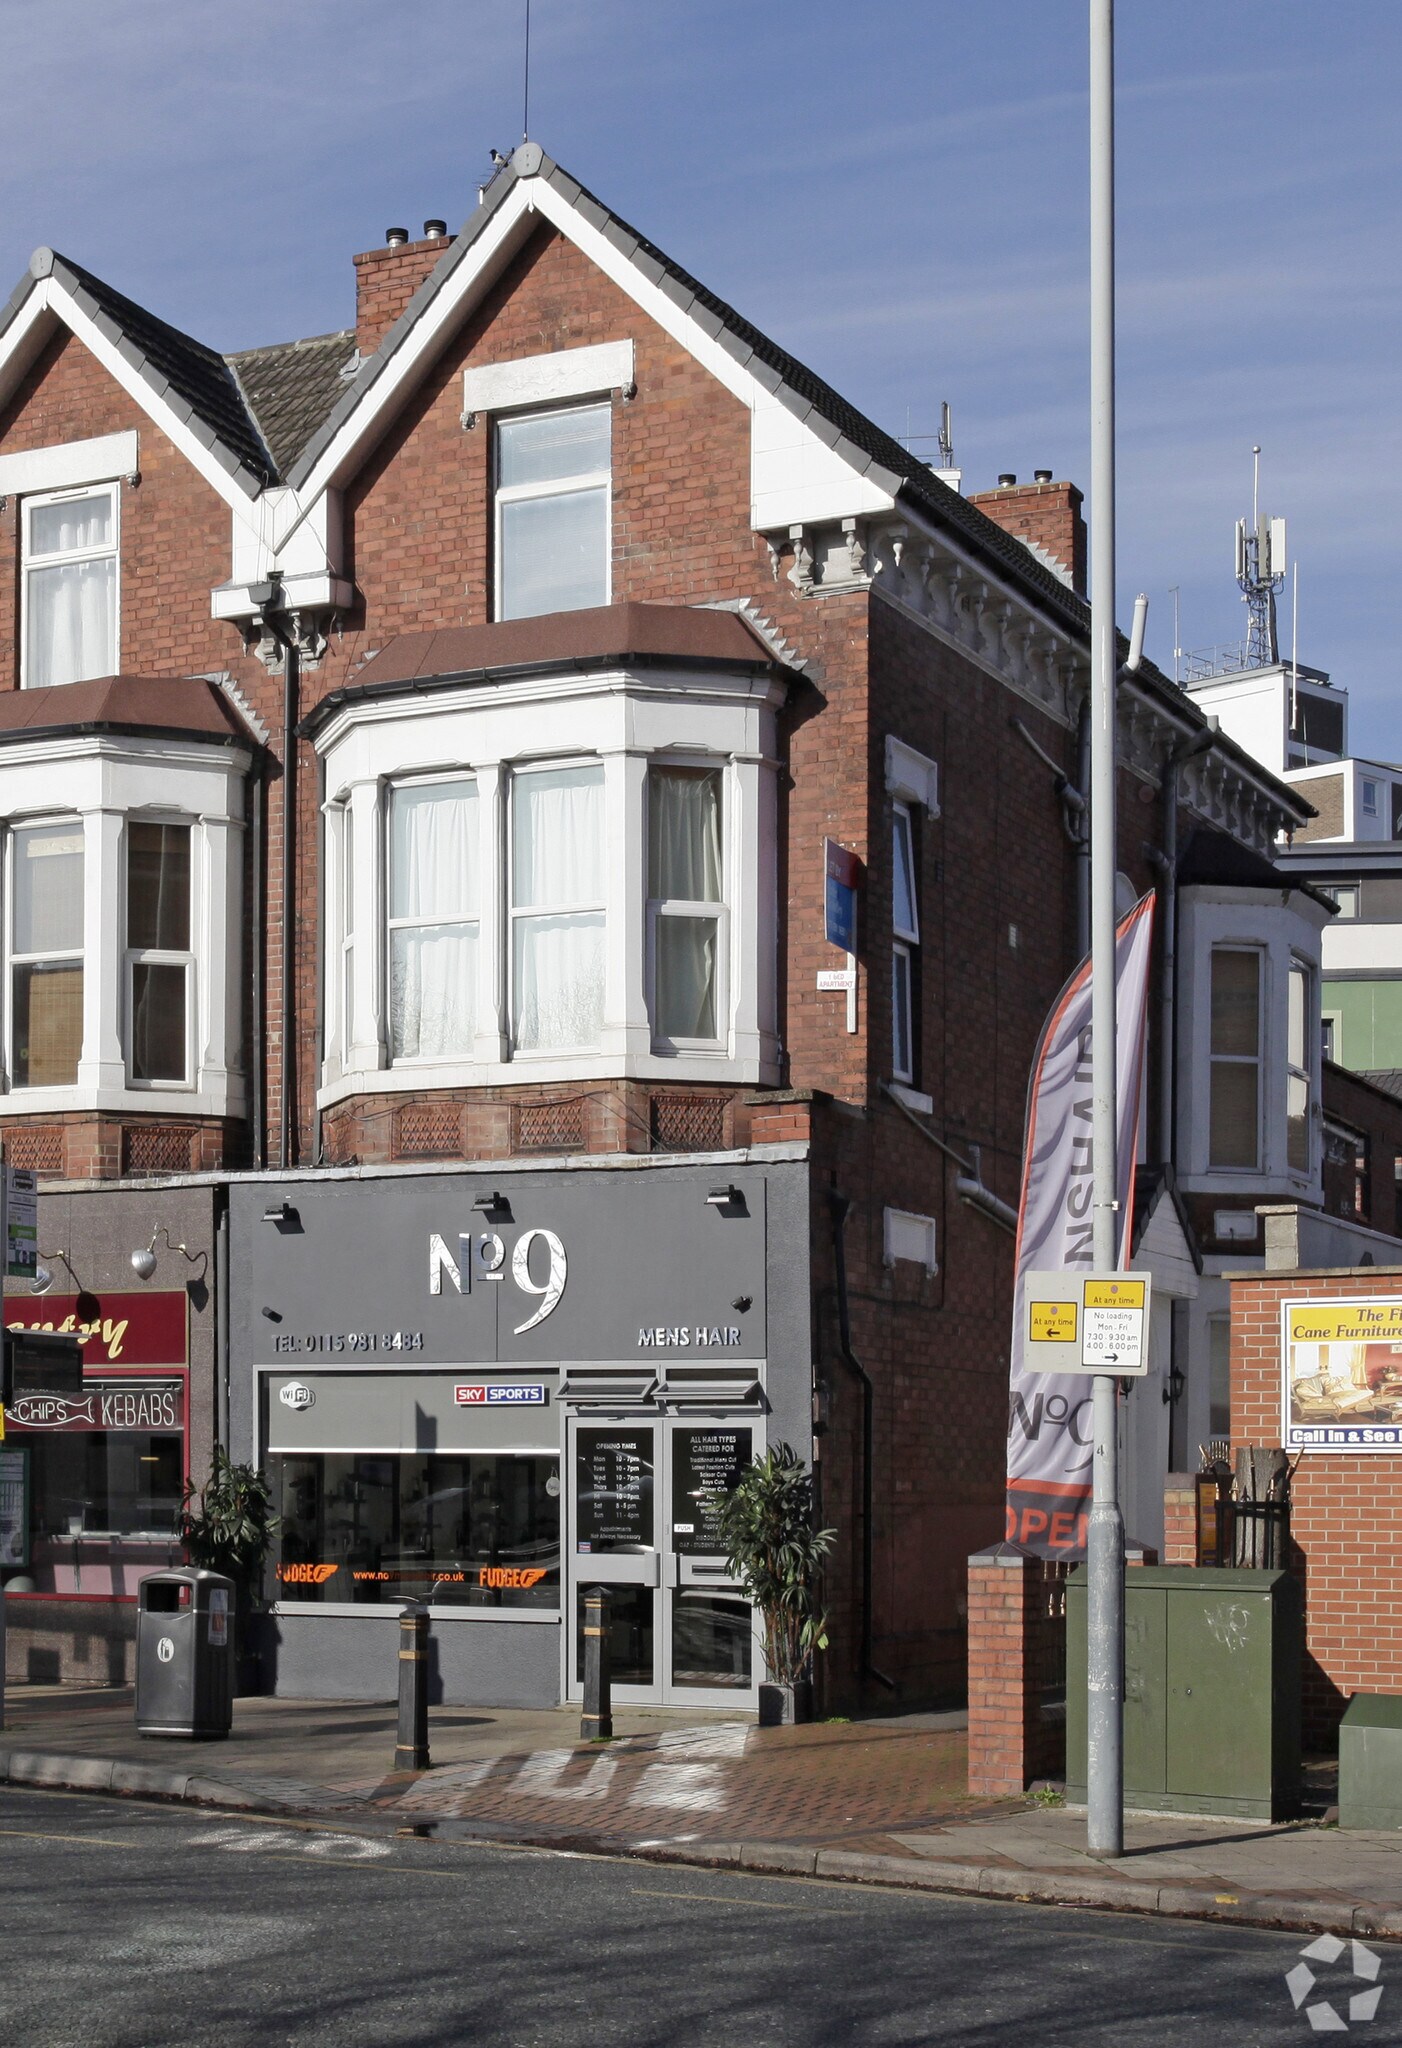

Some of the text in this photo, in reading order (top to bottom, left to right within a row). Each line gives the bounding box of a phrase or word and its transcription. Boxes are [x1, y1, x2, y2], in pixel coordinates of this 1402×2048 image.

[819, 980, 853, 988] APARTMENT
[1106, 1312, 1133, 1321] loading
[1357, 1309, 1384, 1322] The
[638, 1327, 740, 1346] MENS HAIR
[1293, 1325, 1402, 1338] Cane Furniture
[272, 1332, 423, 1351] TEL: 0115 981 8484
[458, 1387, 540, 1400] SKY SPORTS
[18, 1393, 175, 1426] CHIPS KEBABS
[1292, 1429, 1395, 1442] Call In & See
[692, 1445, 720, 1453] CATERED
[479, 1568, 520, 1587] FUDGE
